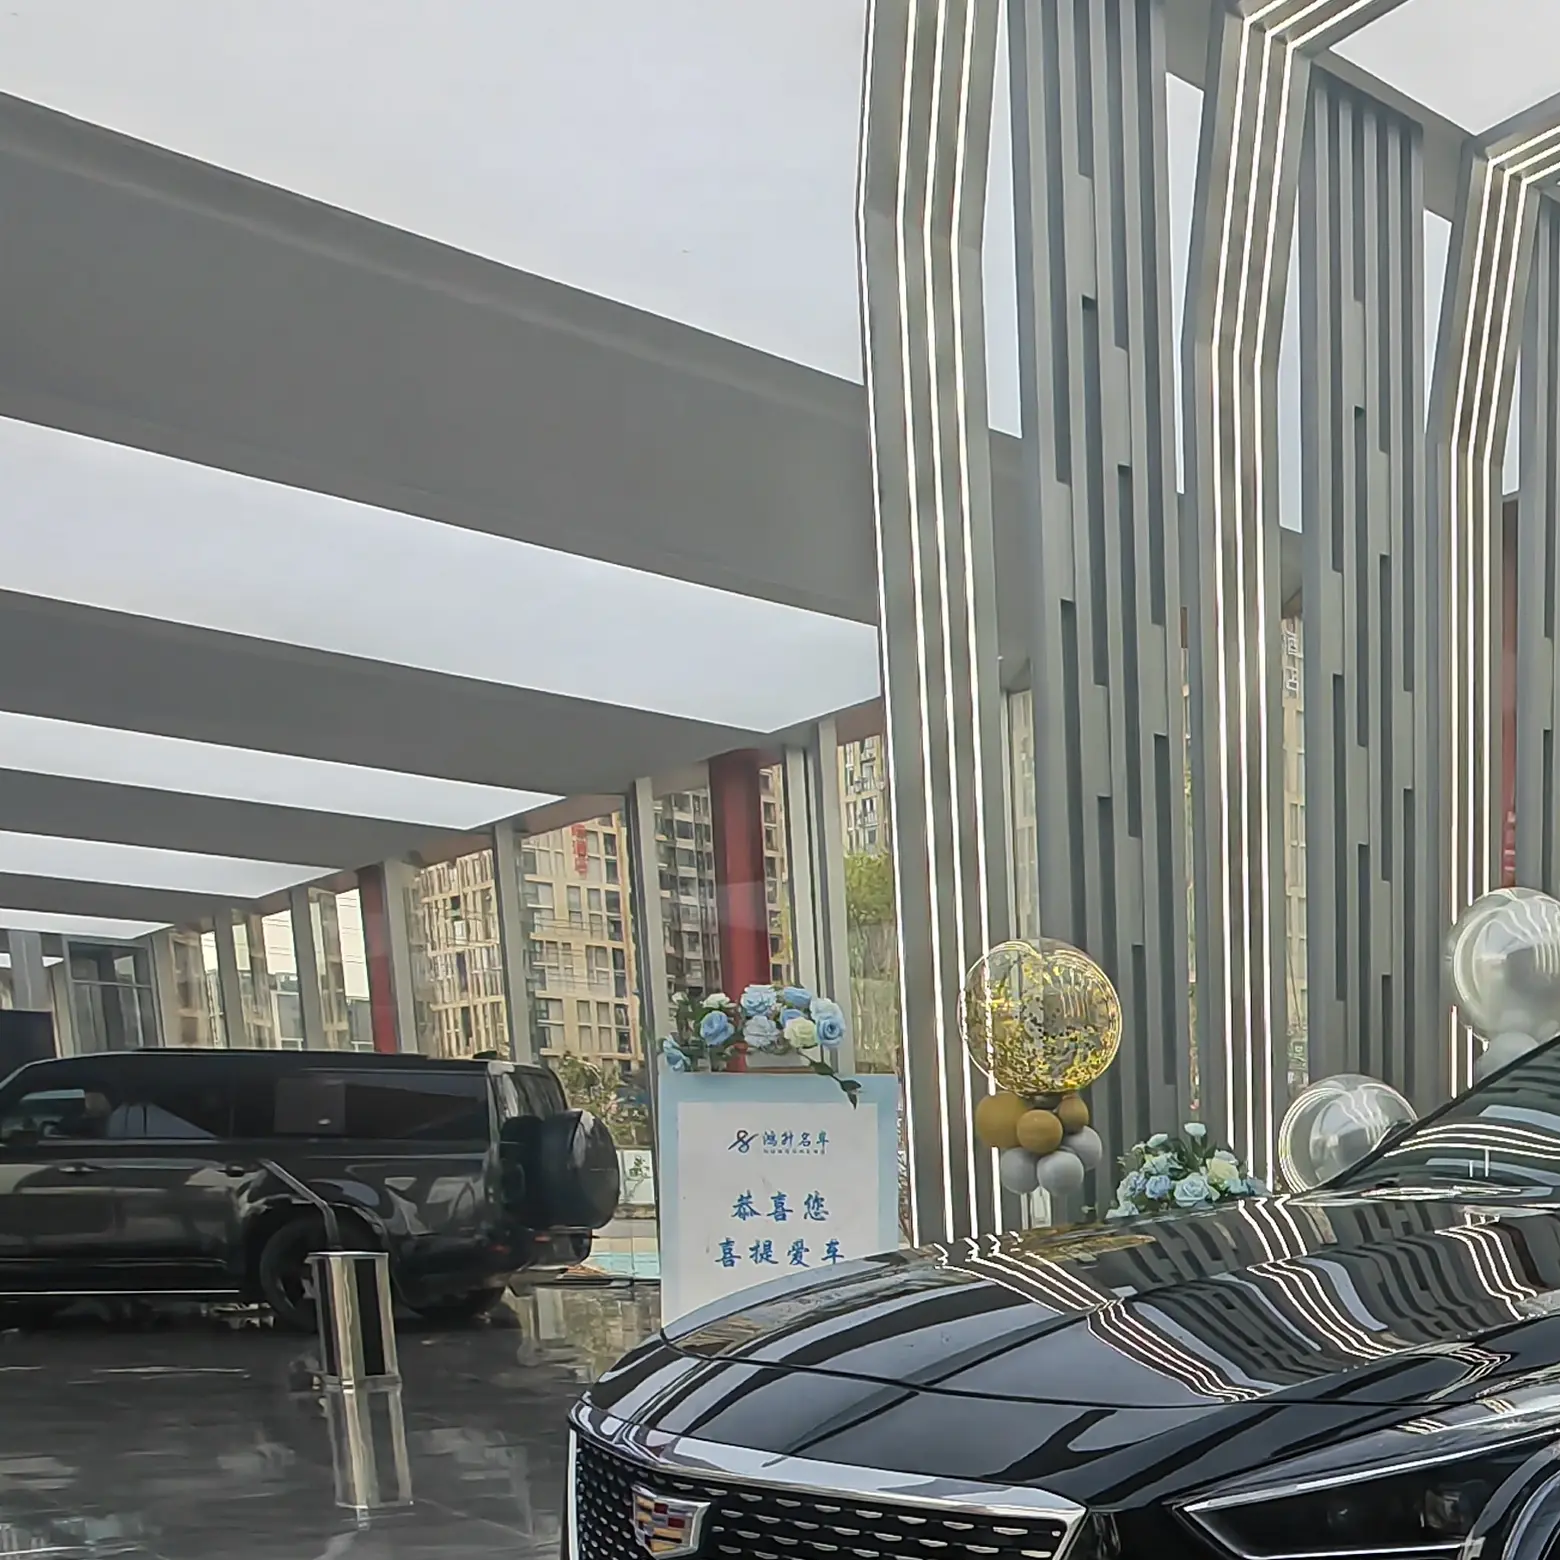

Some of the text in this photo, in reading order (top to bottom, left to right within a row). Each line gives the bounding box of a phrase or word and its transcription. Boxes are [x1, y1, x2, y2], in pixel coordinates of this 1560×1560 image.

[730, 1190, 829, 1221] 恭喜您
[714, 1237, 845, 1267] 喜提爱车
